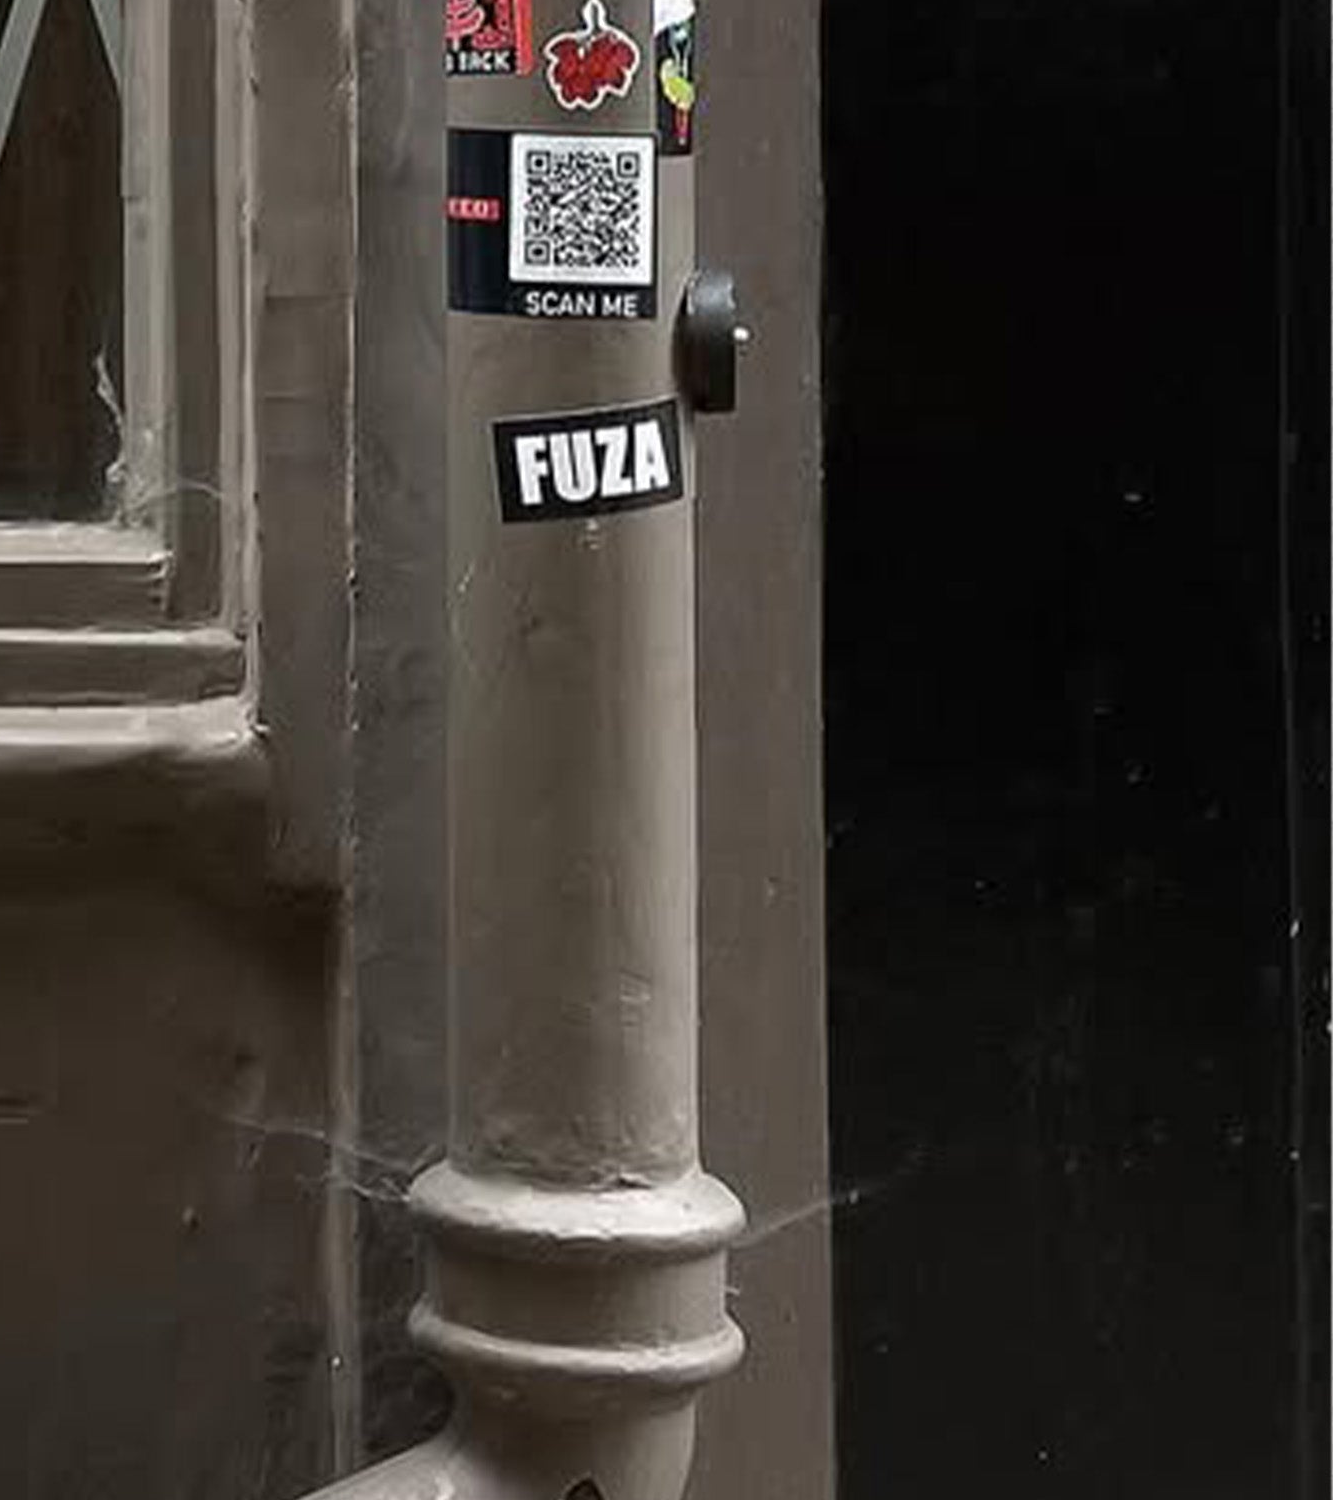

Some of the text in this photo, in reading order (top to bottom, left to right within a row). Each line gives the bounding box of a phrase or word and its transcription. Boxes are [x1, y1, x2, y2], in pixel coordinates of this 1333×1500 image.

[525, 291, 638, 317] SCAN ME
[515, 419, 671, 506] FUZA
